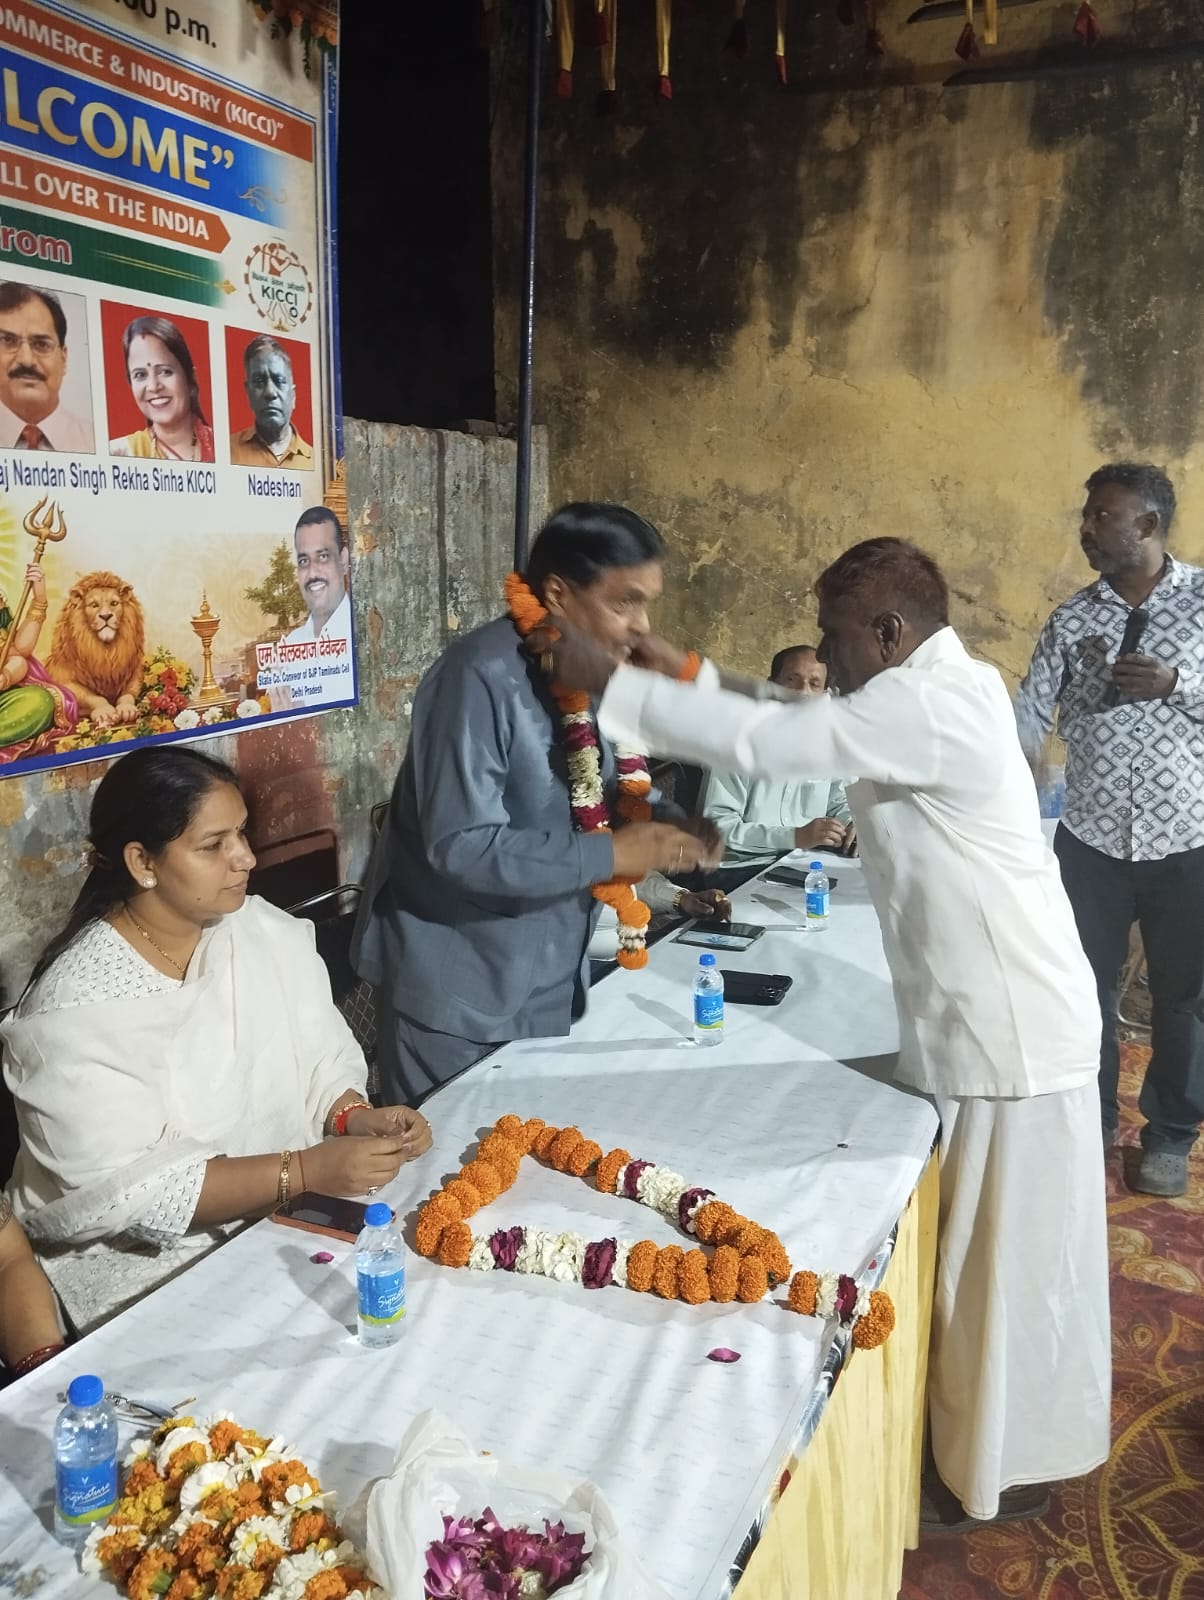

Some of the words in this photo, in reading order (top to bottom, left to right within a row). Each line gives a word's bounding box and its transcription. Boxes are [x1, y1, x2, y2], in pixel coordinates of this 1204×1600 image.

[109, 54, 125, 77] &
[130, 62, 221, 113] INDUSTRY
[34, 172, 99, 209] OVER
[104, 192, 147, 222] THE
[152, 206, 209, 241] INDIA
[261, 284, 298, 306] KICCI
[13, 458, 66, 487] Nandan
[69, 462, 107, 495] Singh
[112, 464, 149, 491] Rekha
[152, 467, 184, 493] Sinha
[186, 469, 216, 494] KICCI
[248, 473, 302, 498] Nadeshan
